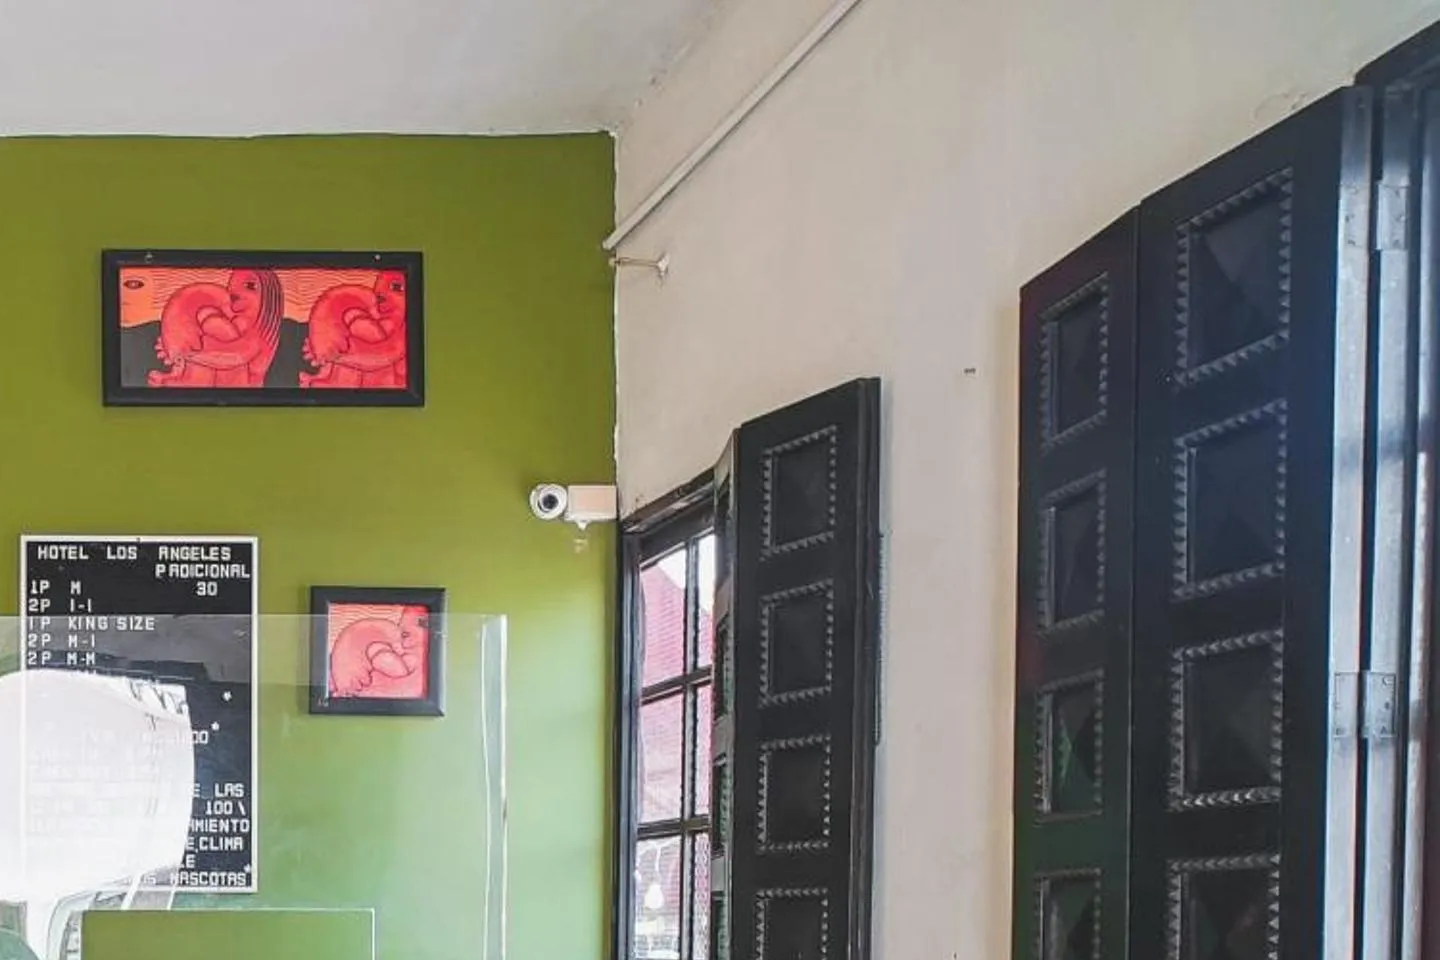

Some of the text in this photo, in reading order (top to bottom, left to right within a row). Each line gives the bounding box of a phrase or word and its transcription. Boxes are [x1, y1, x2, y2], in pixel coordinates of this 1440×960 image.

[37, 545, 232, 561] HOTEL LOS ANGELES
[169, 563, 251, 579] ADICIONAL
[30, 580, 218, 596] 1P M 30
[28, 598, 51, 613] 2P
[68, 616, 109, 631] KING
[116, 616, 156, 631] SIZE
[28, 633, 51, 648] 2P
[28, 651, 51, 665] 2P
[214, 783, 245, 798] LAS
[205, 800, 233, 815] 100
[170, 871, 247, 886] MASCOTAS
